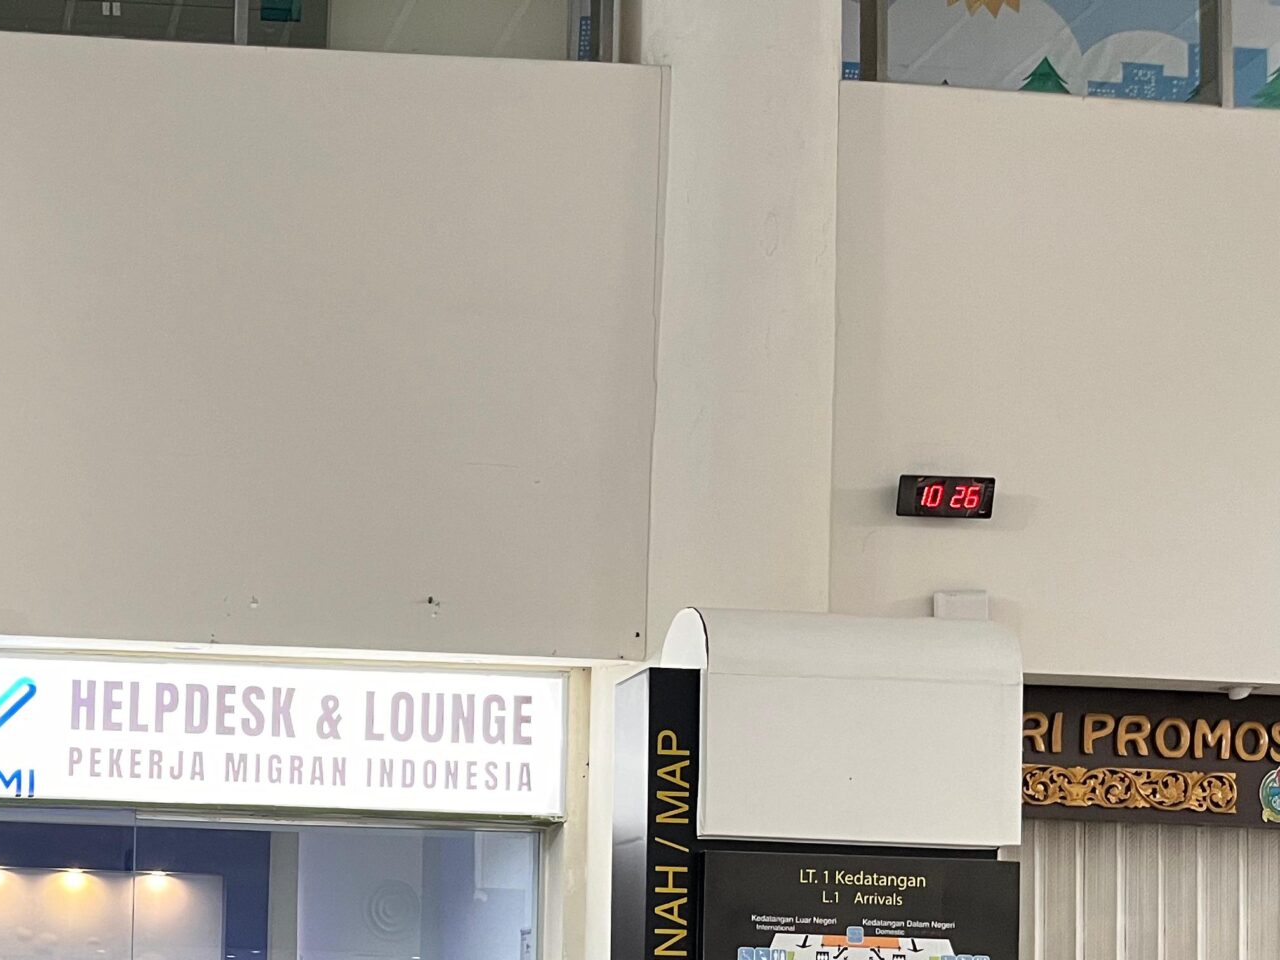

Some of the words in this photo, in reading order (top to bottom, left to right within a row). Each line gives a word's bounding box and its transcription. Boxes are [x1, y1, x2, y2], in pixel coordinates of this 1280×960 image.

[920, 485, 944, 507] 10
[949, 486, 980, 508] 26
[71, 680, 296, 738] HELPDESK
[315, 694, 343, 740] &
[364, 691, 532, 746] LOUNGE
[68, 747, 205, 781] PEKERJA
[224, 752, 347, 787] MIGRAN
[365, 758, 532, 792] INDONESIA
[656, 729, 690, 824] MAP
[654, 837, 690, 852] /
[799, 869, 818, 884] LT.
[823, 870, 829, 884] 1
[835, 870, 926, 891] Kedatangan
[822, 891, 839, 903] L.1
[854, 892, 903, 906] Arrivals
[751, 914, 794, 924] Kedatangan
[795, 916, 812, 924] Luar
[813, 916, 837, 926] Negeri
[756, 923, 795, 931] International
[862, 918, 905, 928] Kedatangan
[906, 920, 930, 928] Dalam
[931, 921, 955, 930] Negeri
